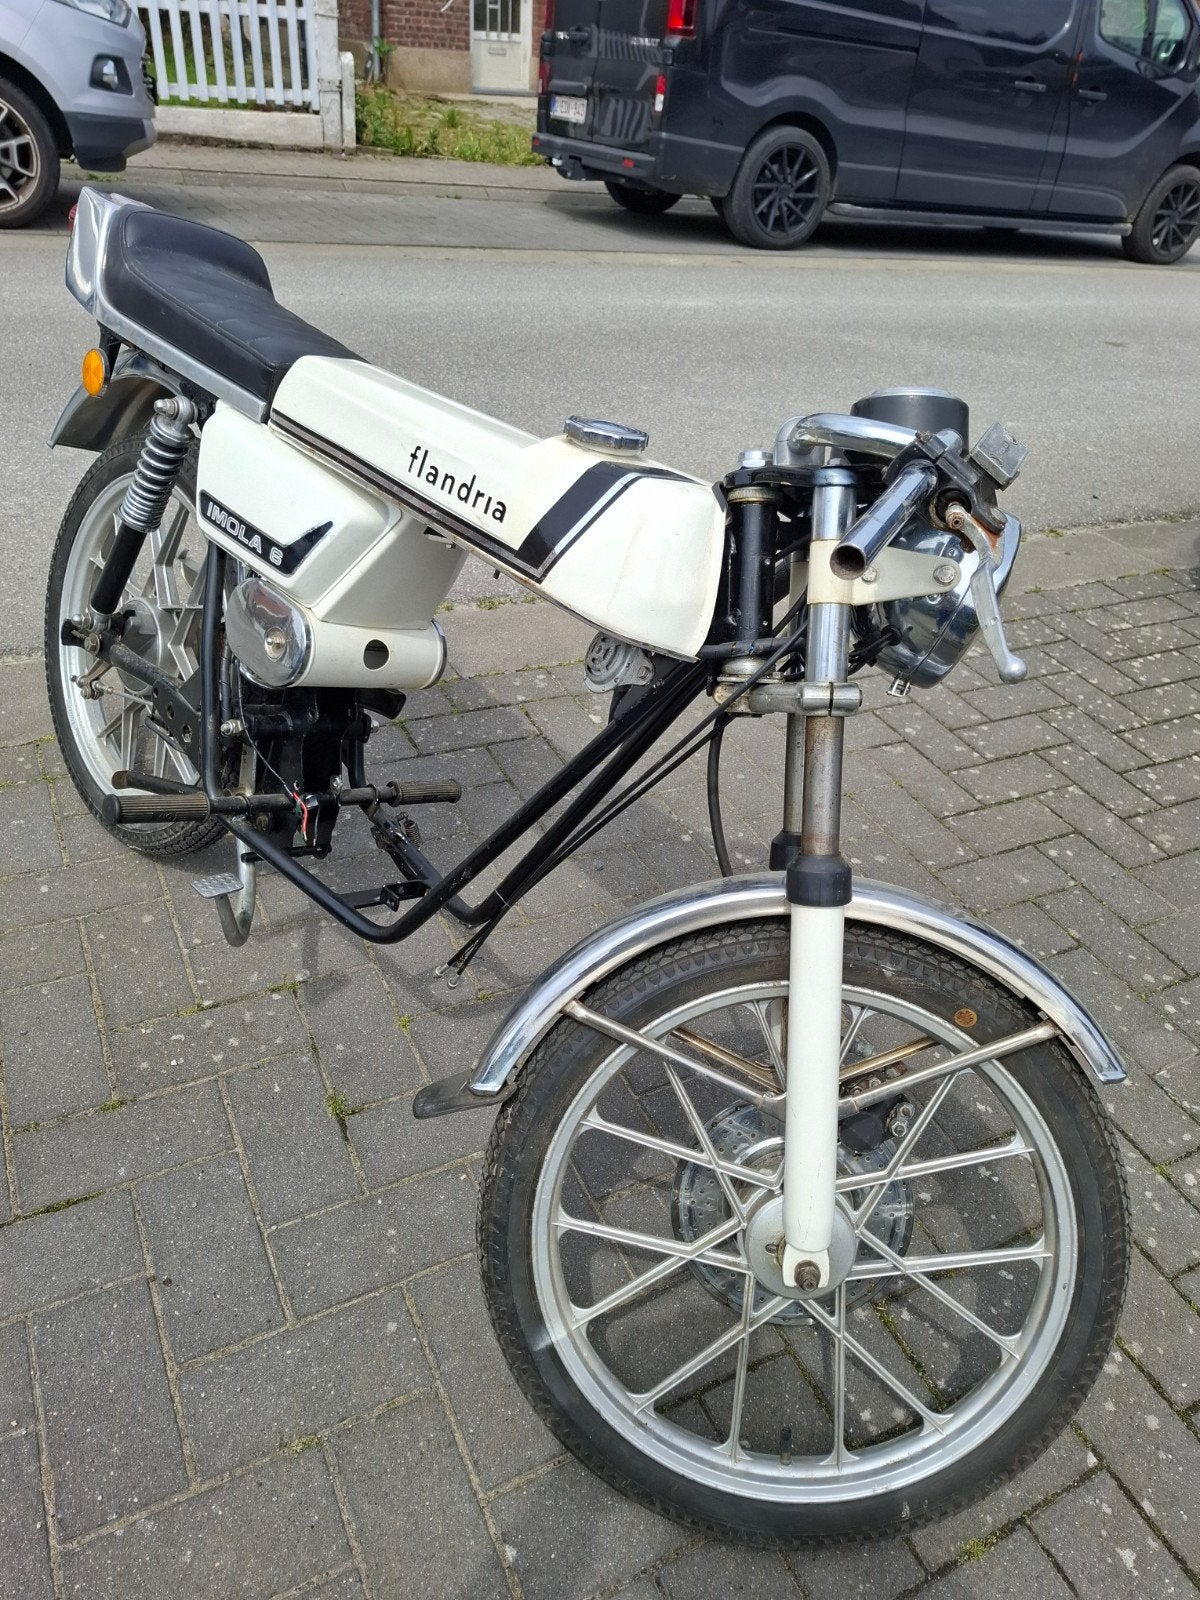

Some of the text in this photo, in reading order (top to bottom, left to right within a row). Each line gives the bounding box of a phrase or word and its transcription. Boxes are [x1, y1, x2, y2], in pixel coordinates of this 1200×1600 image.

[408, 445, 507, 523] flandria
[206, 501, 284, 566] IMOLA 6
